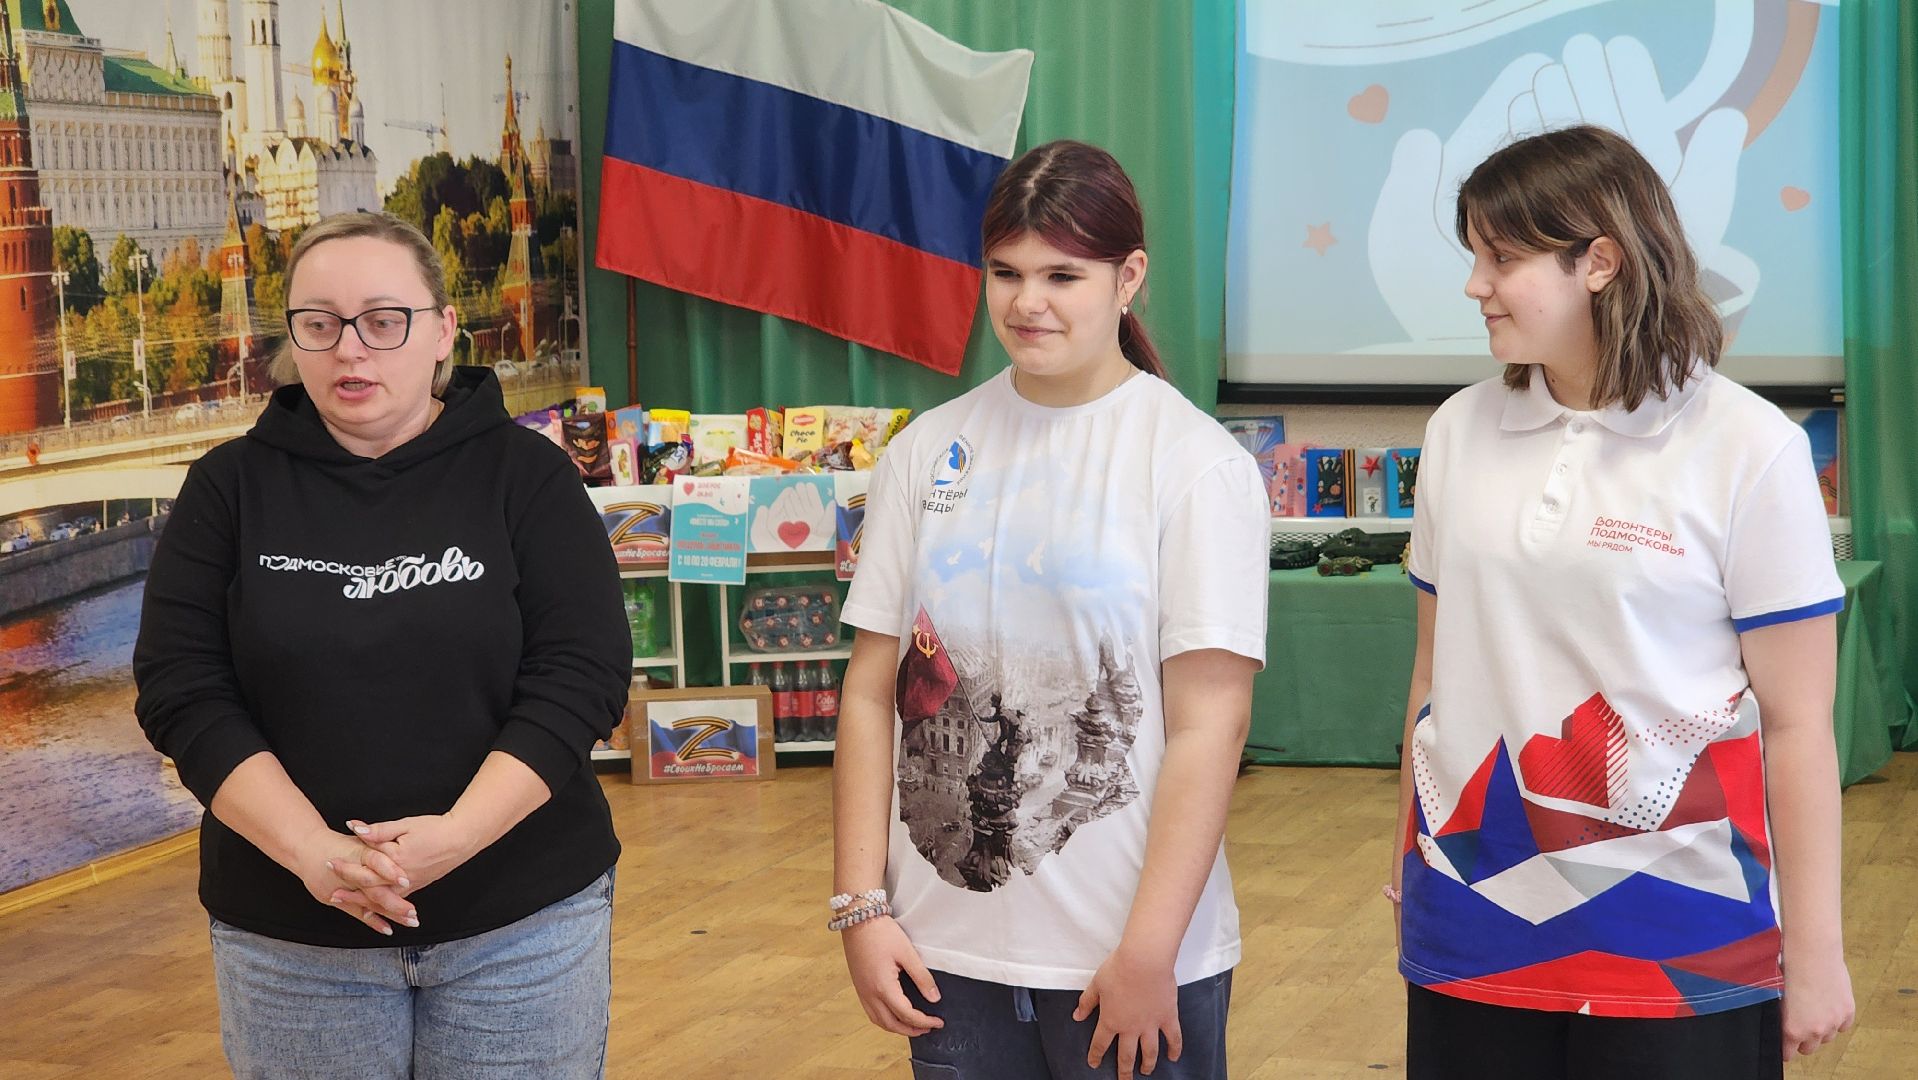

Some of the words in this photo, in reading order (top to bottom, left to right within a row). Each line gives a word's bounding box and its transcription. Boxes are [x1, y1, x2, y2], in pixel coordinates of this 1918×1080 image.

[929, 489, 968, 501] НТЁРЫ
[1594, 516, 1673, 541] ВОЛОНТЕРЫ
[1587, 539, 1601, 548] МЫ
[1601, 541, 1633, 552] РЯДОМ
[1590, 527, 1685, 557] ПОДМОСКОВЬЯ
[663, 763, 744, 774] #СвоихНеБросаем
